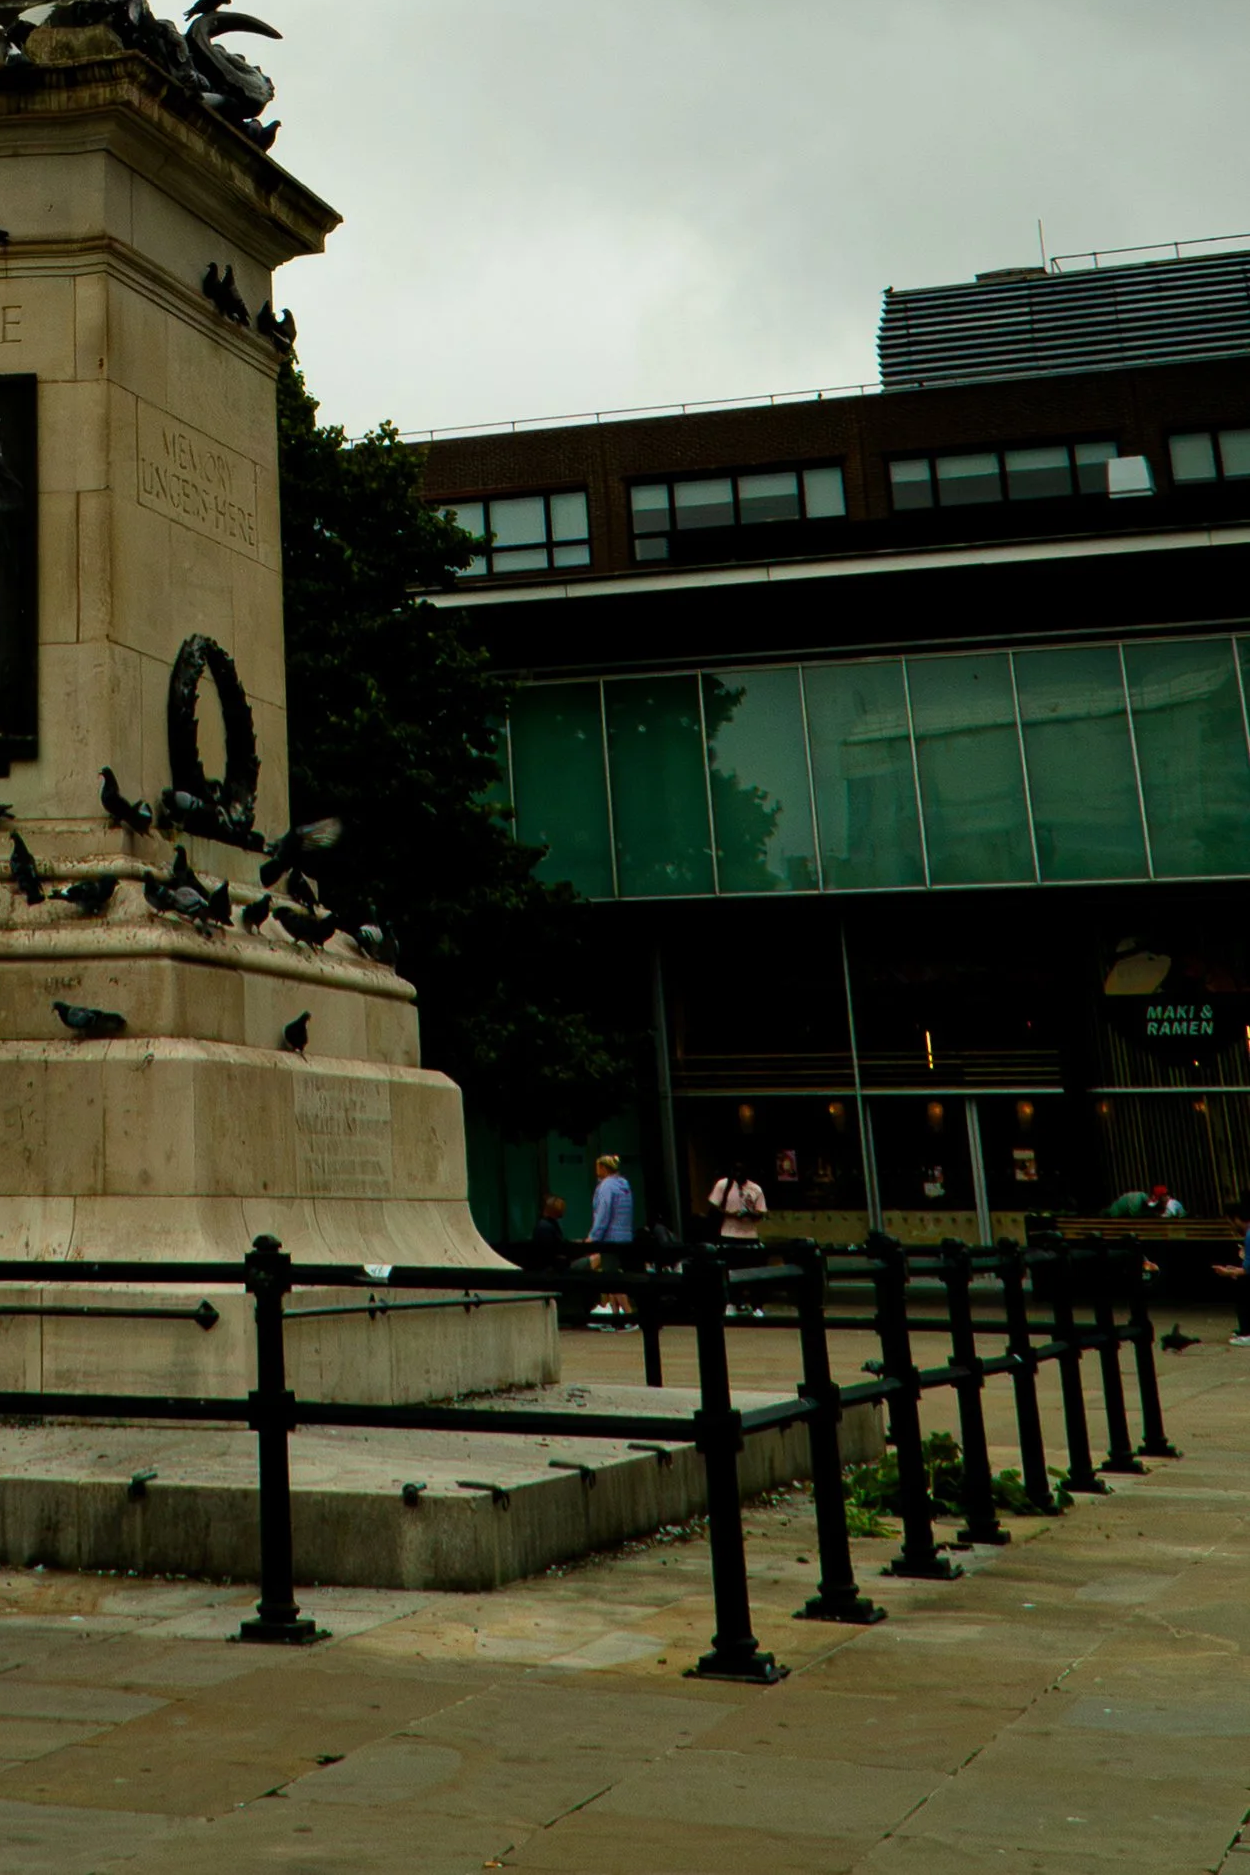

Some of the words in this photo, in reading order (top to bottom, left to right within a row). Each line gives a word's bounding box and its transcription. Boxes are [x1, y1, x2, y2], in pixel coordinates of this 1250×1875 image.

[161, 427, 236, 496] MEMORY
[141, 457, 209, 523] LINGERS
[213, 495, 256, 547] HERE
[1146, 1005, 1196, 1020] MAKI
[1199, 1004, 1214, 1019] &
[1147, 1021, 1215, 1037] RAMEN
